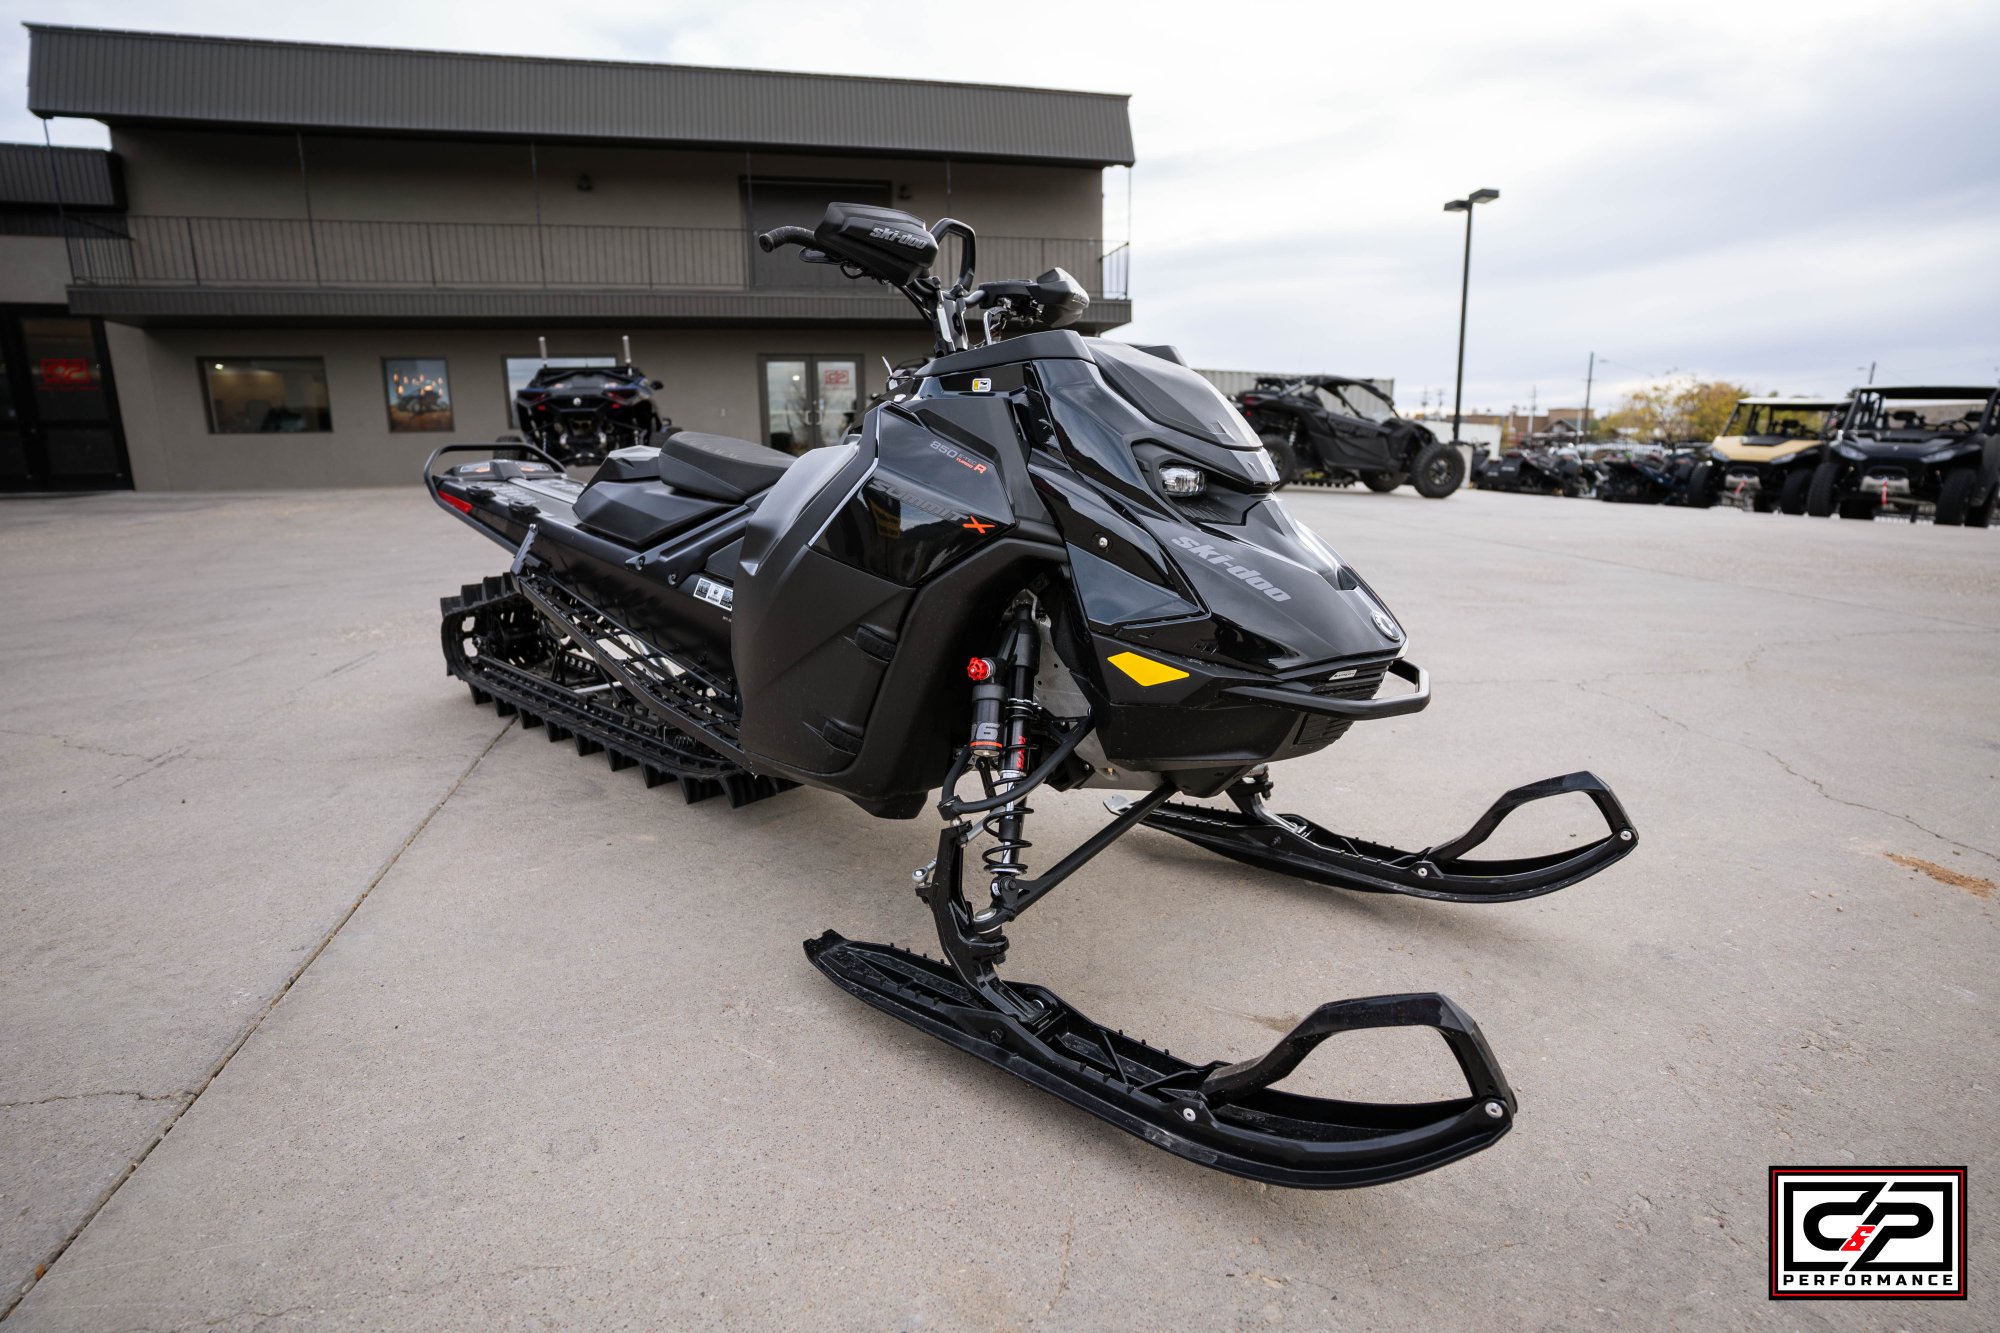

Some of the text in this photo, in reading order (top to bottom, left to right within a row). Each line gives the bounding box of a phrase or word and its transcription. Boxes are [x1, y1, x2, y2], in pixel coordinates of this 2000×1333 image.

[930, 440, 958, 459] 850
[973, 463, 988, 474] R
[962, 515, 996, 534] X
[1171, 536, 1292, 602] ski-doo
